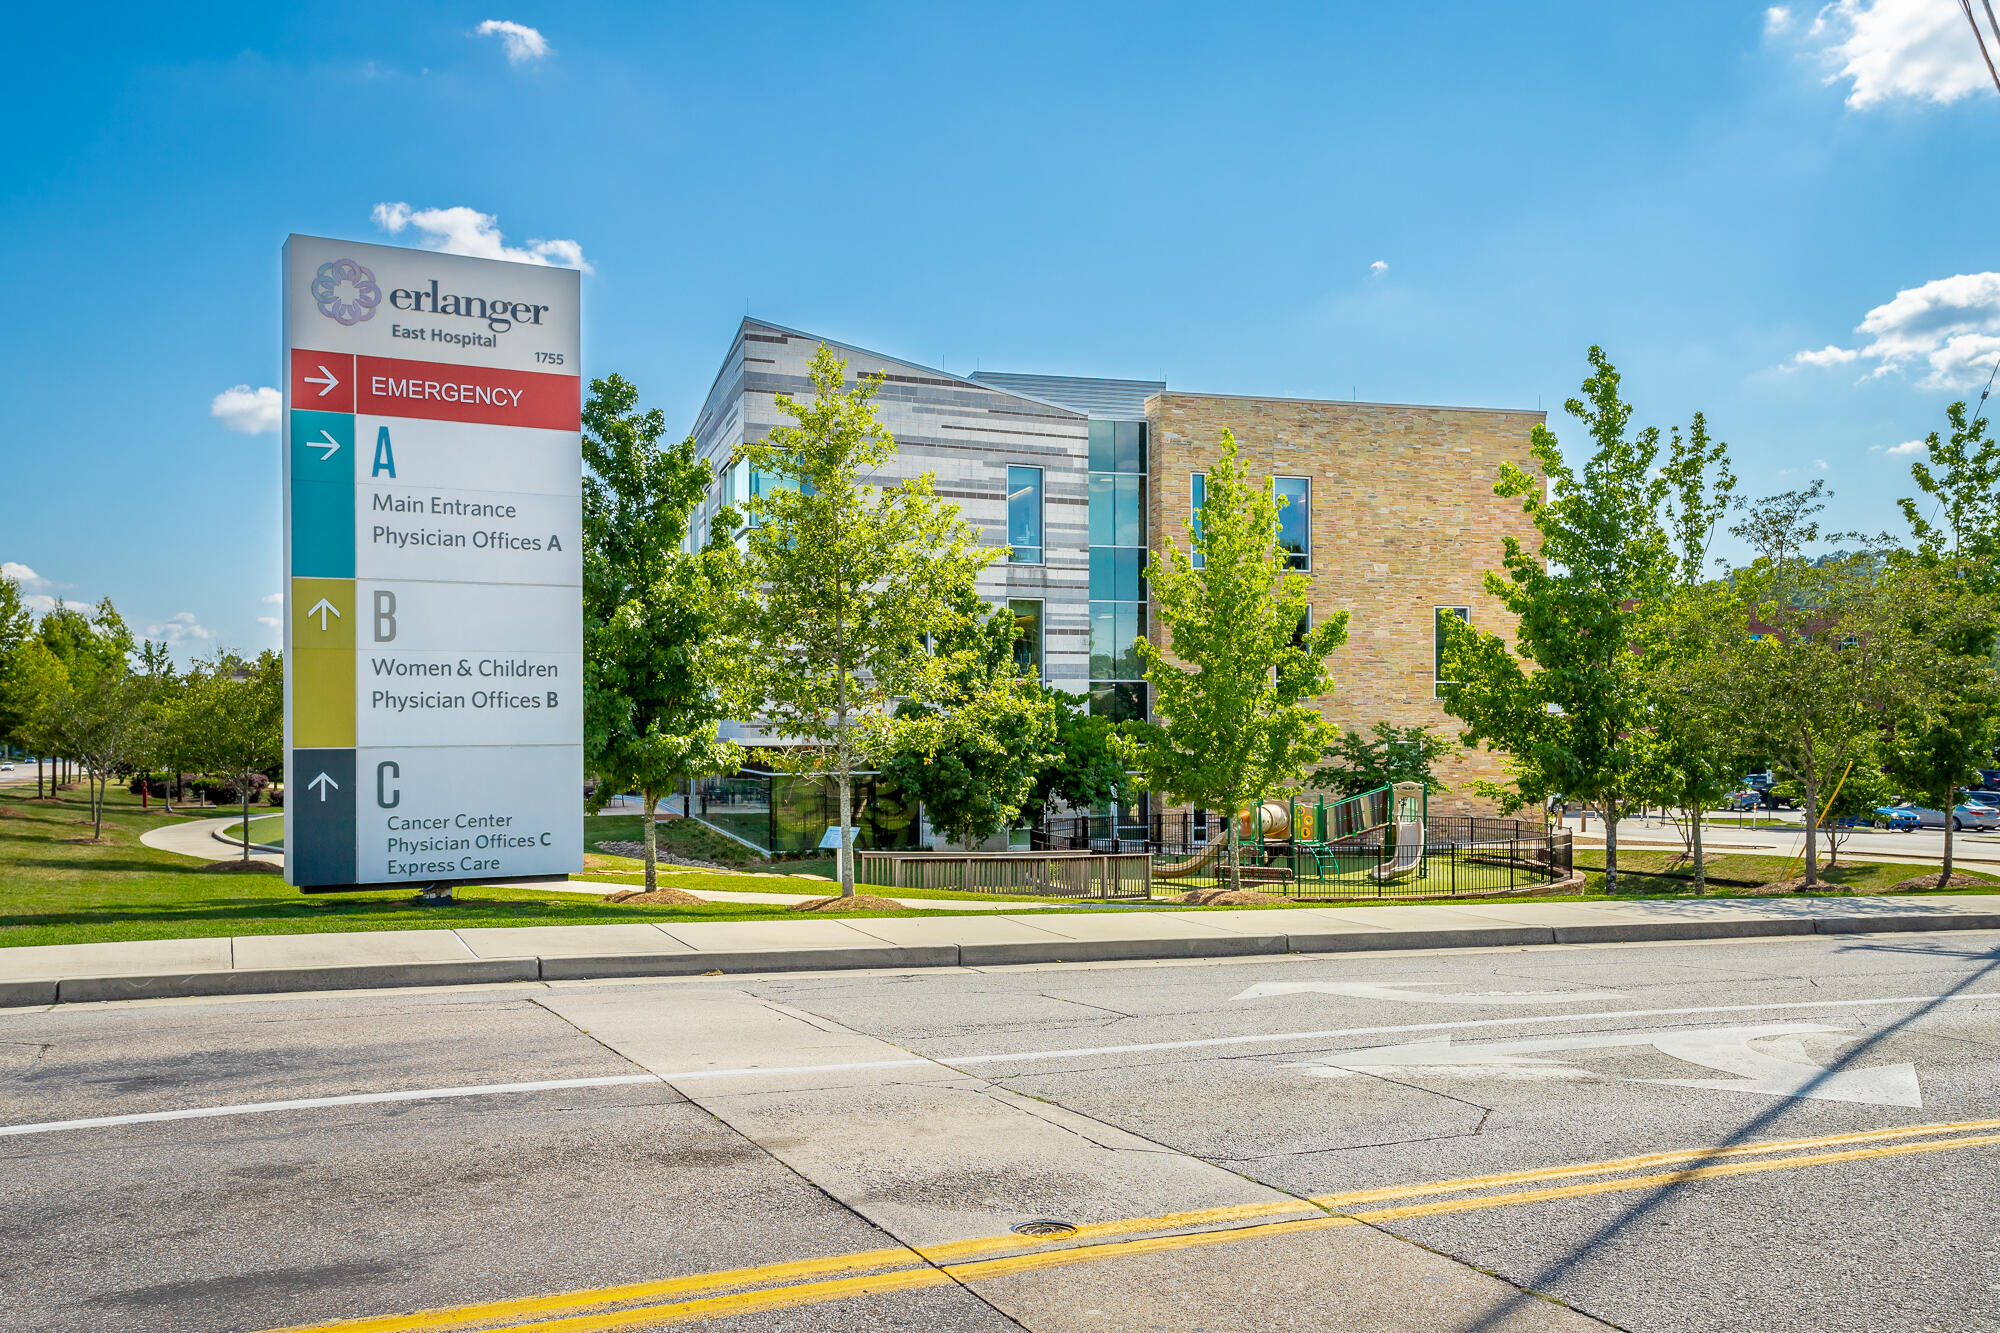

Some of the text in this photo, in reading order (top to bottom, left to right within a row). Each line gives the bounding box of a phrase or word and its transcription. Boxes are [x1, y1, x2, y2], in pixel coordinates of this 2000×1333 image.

[389, 279, 548, 333] erlanger
[392, 324, 497, 348] East Hospital
[535, 351, 564, 365] 1755
[371, 376, 523, 407] EMERGENCY
[371, 426, 396, 478] A
[373, 493, 516, 518] Main Entrance
[373, 526, 562, 551] Physician Offices A
[373, 590, 396, 642] B
[372, 658, 558, 677] Women & Children
[372, 691, 558, 712] Physician Offices B
[377, 761, 400, 809] C
[387, 813, 512, 831] Cancer Center
[387, 832, 551, 855] Physician Offices C
[387, 856, 500, 876] Express Care
